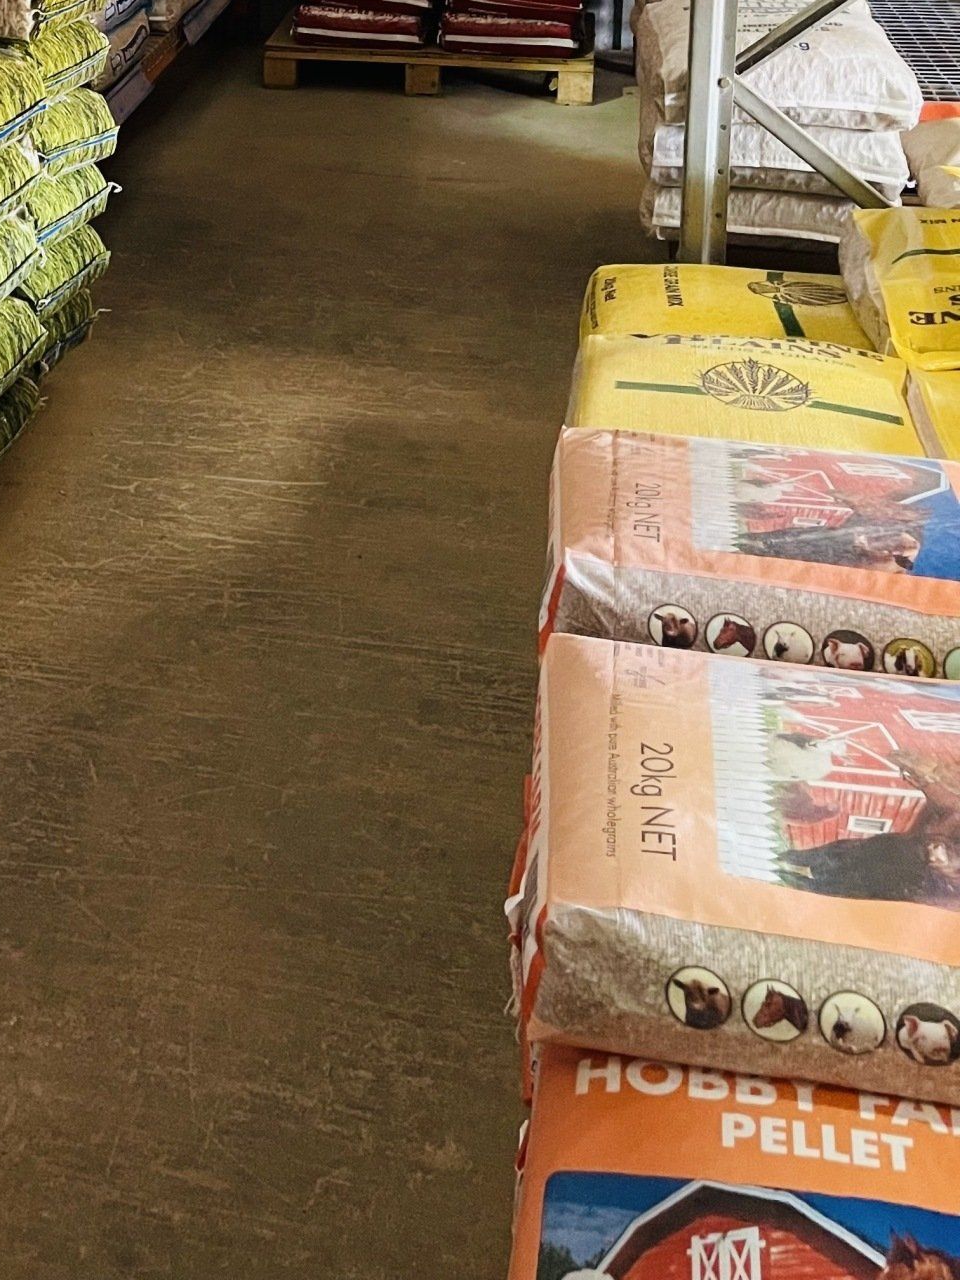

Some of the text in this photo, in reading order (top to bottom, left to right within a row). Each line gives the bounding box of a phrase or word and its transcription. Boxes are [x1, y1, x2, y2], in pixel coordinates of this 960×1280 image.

[667, 294, 684, 307] MIX
[626, 483, 664, 543] 20kg NET
[605, 796, 622, 858] wholegrains
[630, 742, 677, 862] 20kg NET
[575, 1055, 815, 1113] HOBBY
[721, 1111, 915, 1173] PELLET
